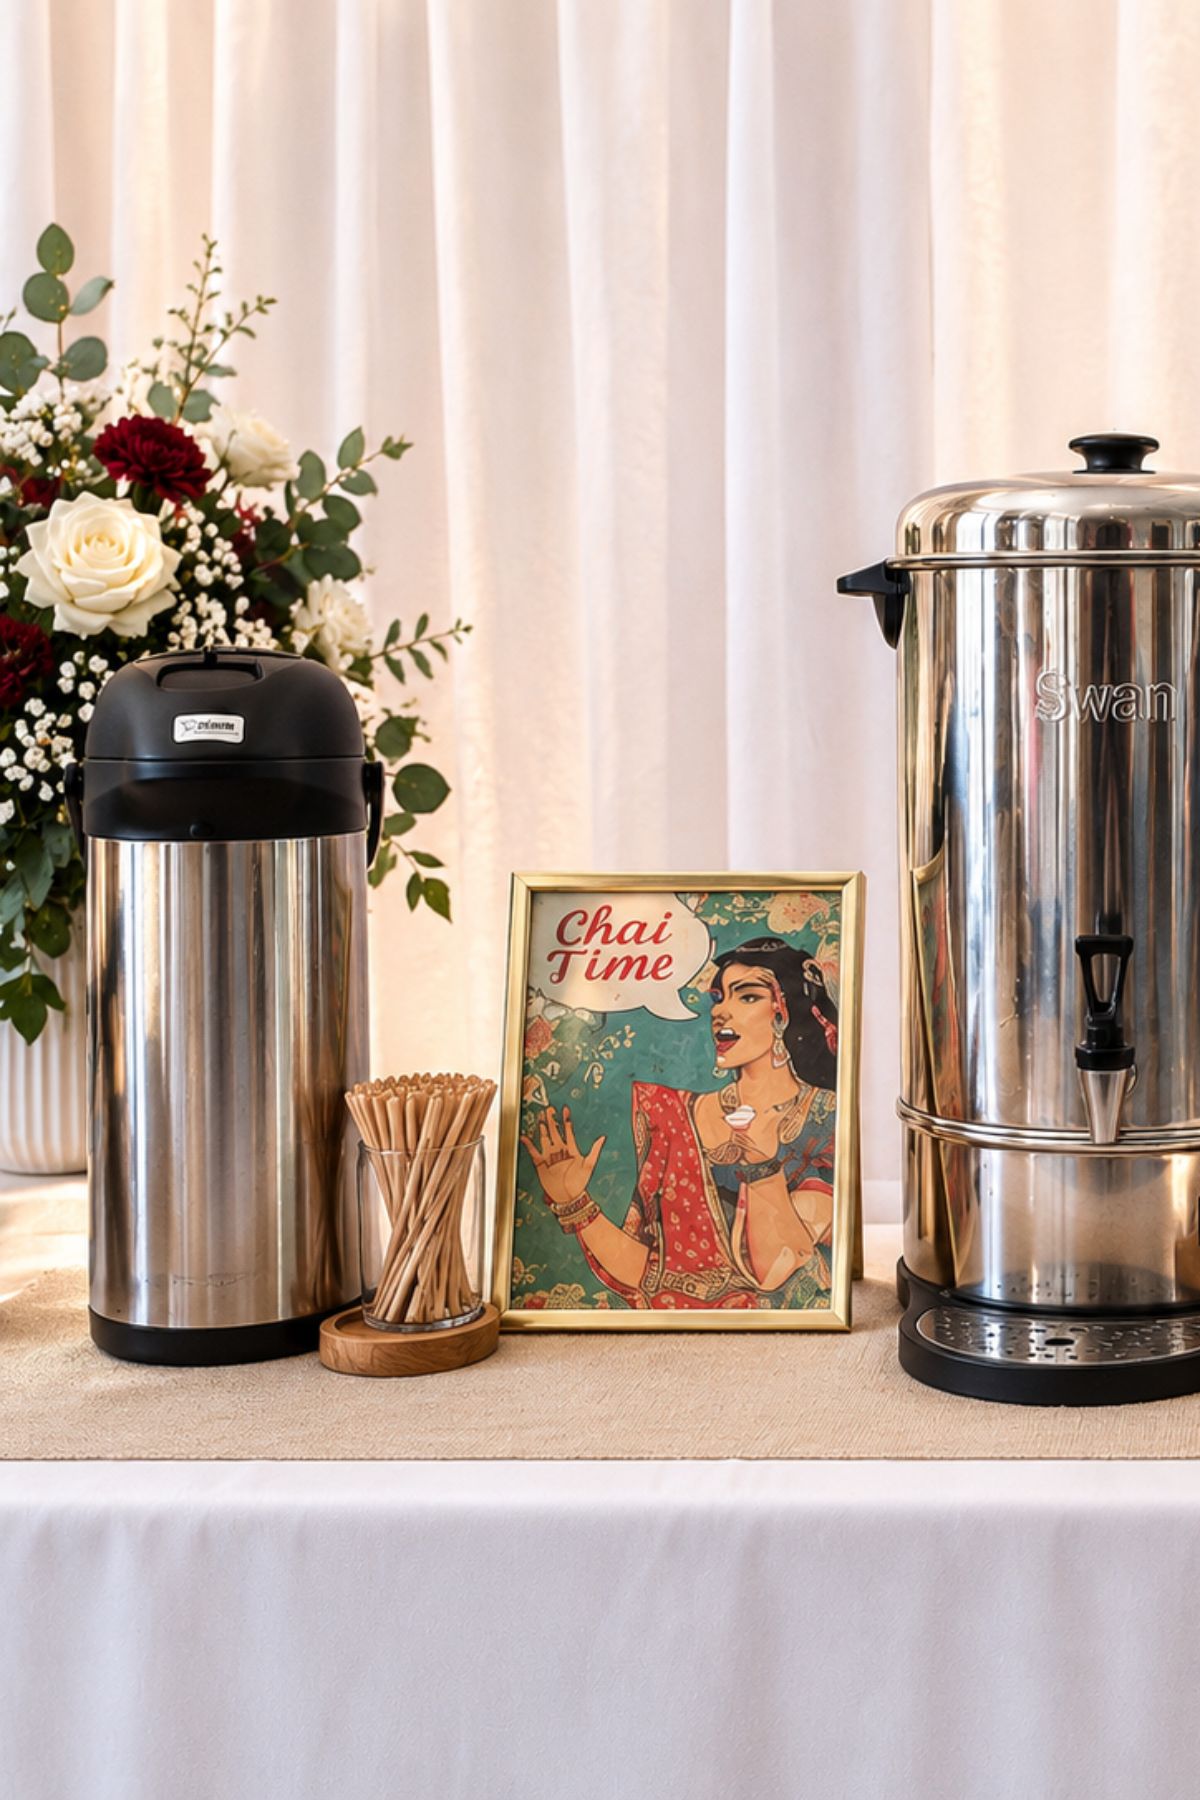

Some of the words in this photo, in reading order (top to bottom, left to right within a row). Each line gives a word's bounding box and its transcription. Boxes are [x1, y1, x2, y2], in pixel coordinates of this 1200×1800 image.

[1035, 669, 1177, 723] Swan
[556, 905, 673, 946] Chai
[546, 949, 674, 985] Time
